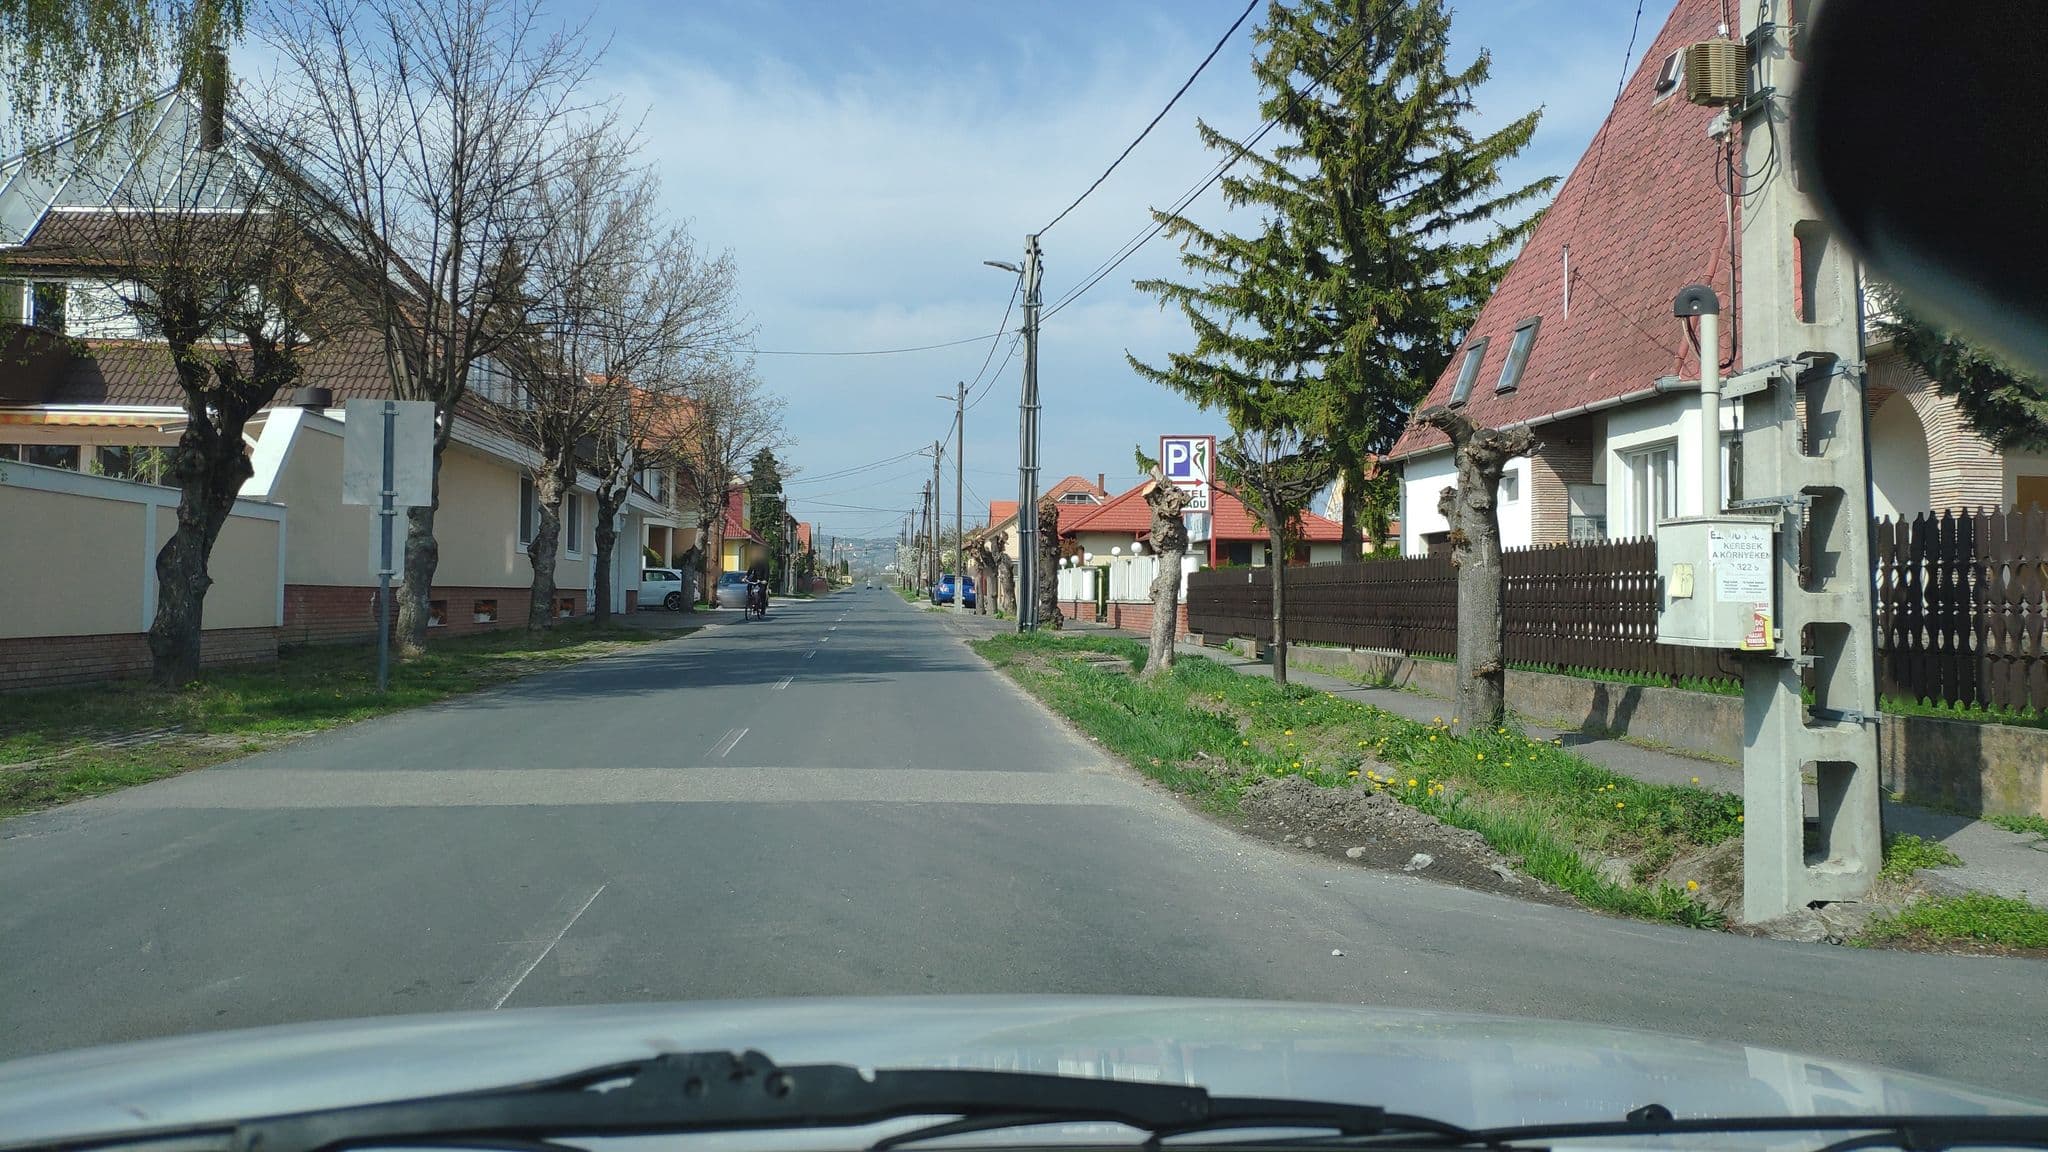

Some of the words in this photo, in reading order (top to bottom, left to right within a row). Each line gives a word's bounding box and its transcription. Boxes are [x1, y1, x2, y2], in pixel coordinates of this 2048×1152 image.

[1168, 444, 1187, 474] P
[1183, 489, 1206, 498] TEL
[1184, 500, 1206, 508] ADU
